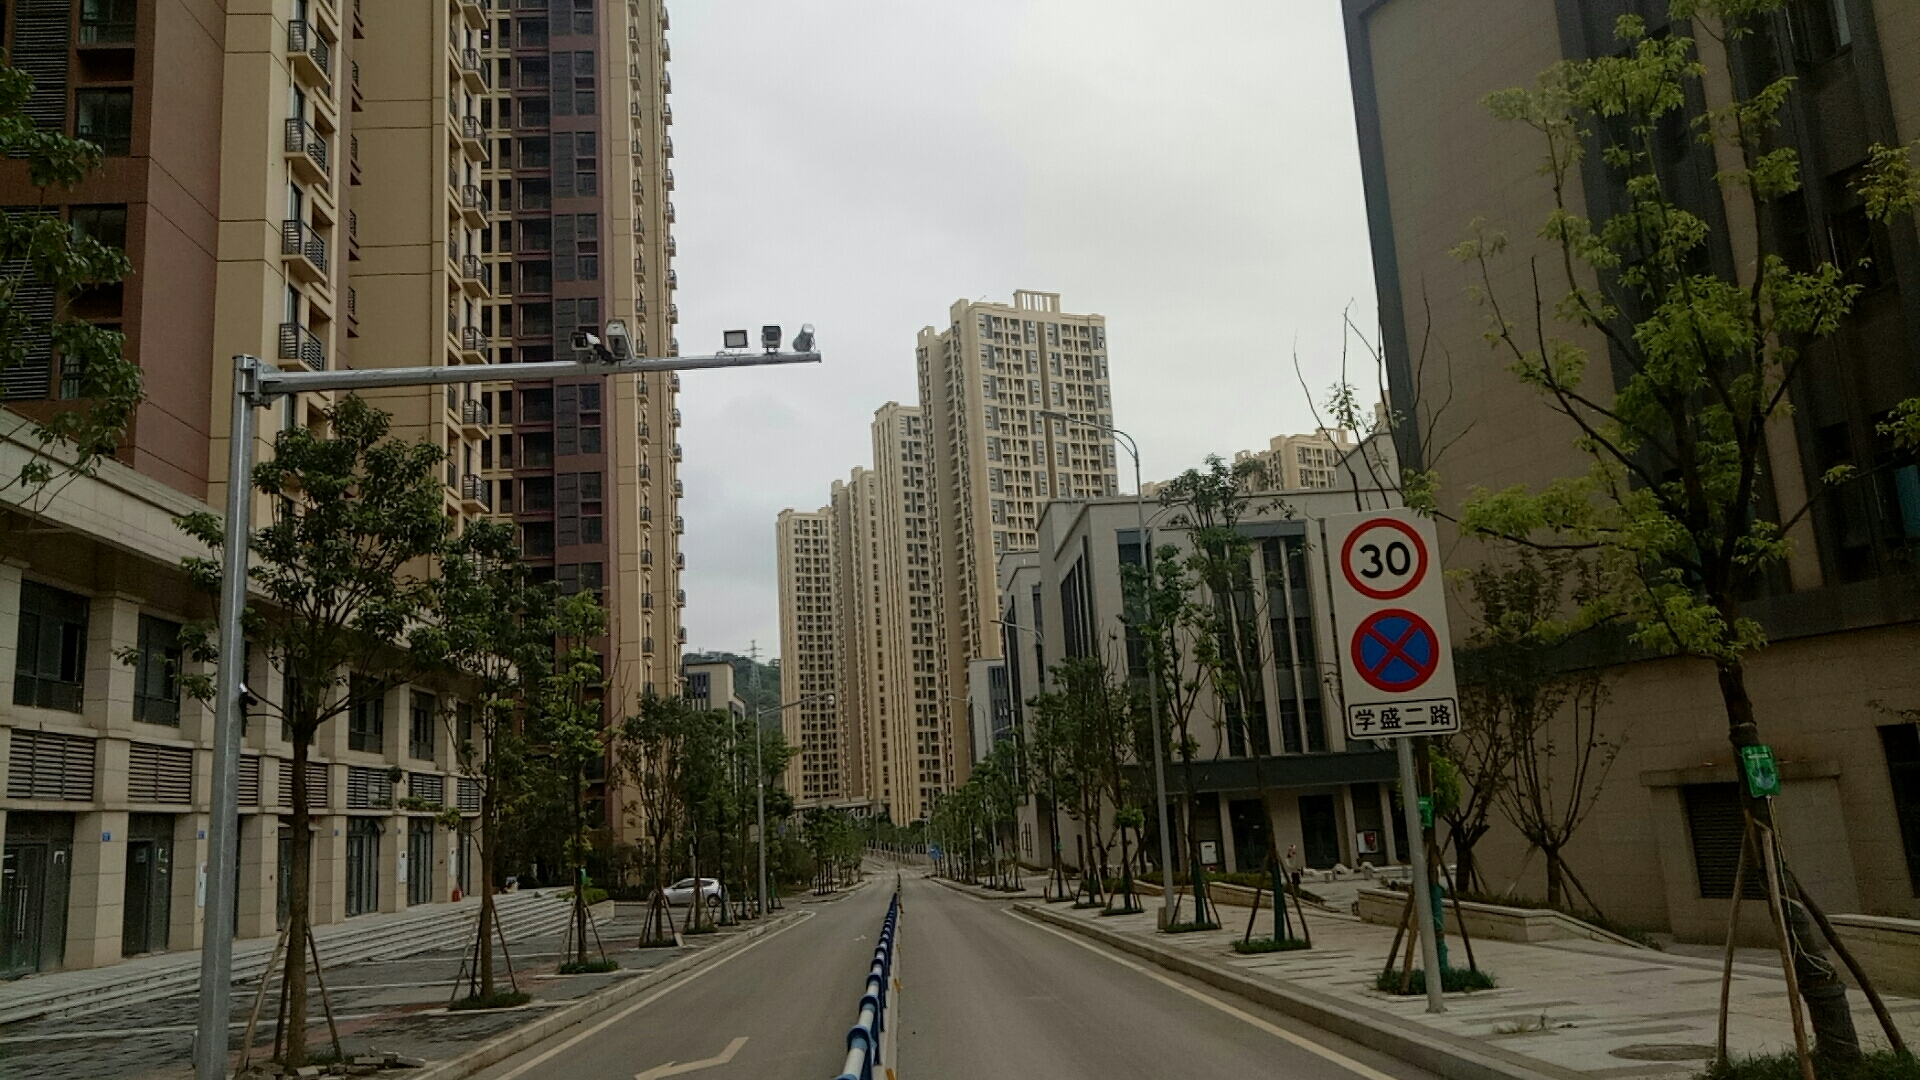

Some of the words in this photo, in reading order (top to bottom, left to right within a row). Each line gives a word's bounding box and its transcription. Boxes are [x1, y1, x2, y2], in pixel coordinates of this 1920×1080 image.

[1359, 541, 1411, 579] 30
[1355, 705, 1450, 731] 学盛二路
